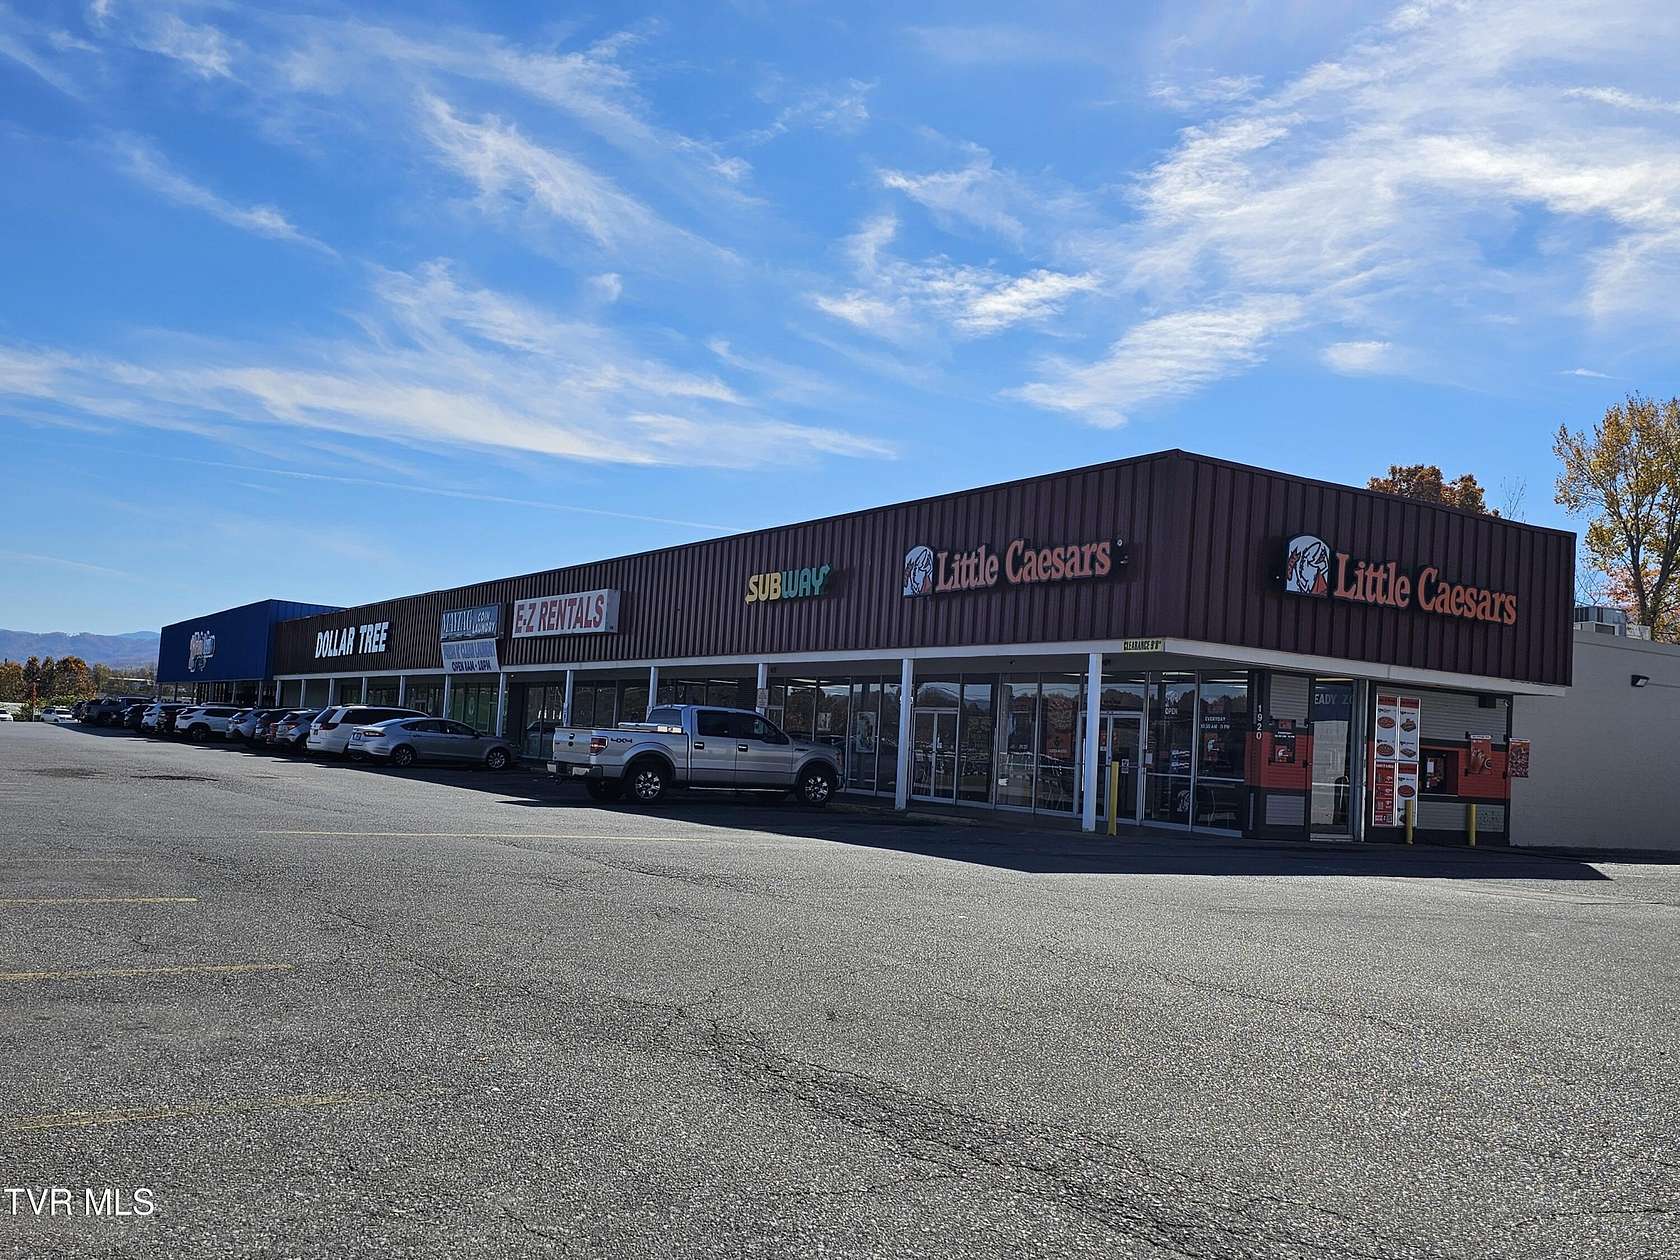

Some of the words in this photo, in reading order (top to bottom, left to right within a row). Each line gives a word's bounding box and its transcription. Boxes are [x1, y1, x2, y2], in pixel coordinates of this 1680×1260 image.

[744, 563, 831, 605] SUBWAY
[936, 544, 999, 592] Little
[1005, 539, 1111, 583] Caesars
[1333, 552, 1411, 608] Little
[1417, 567, 1517, 625] Caesars
[514, 602, 535, 633] E-Z
[537, 594, 605, 632] RENTALS
[314, 626, 355, 659] DOLLAR
[358, 621, 390, 655] TREE
[1123, 641, 1150, 651] CLEARANCE
[451, 661, 464, 672] OPEN
[1164, 707, 1178, 715] OPEN
[1255, 704, 1264, 740] 1920
